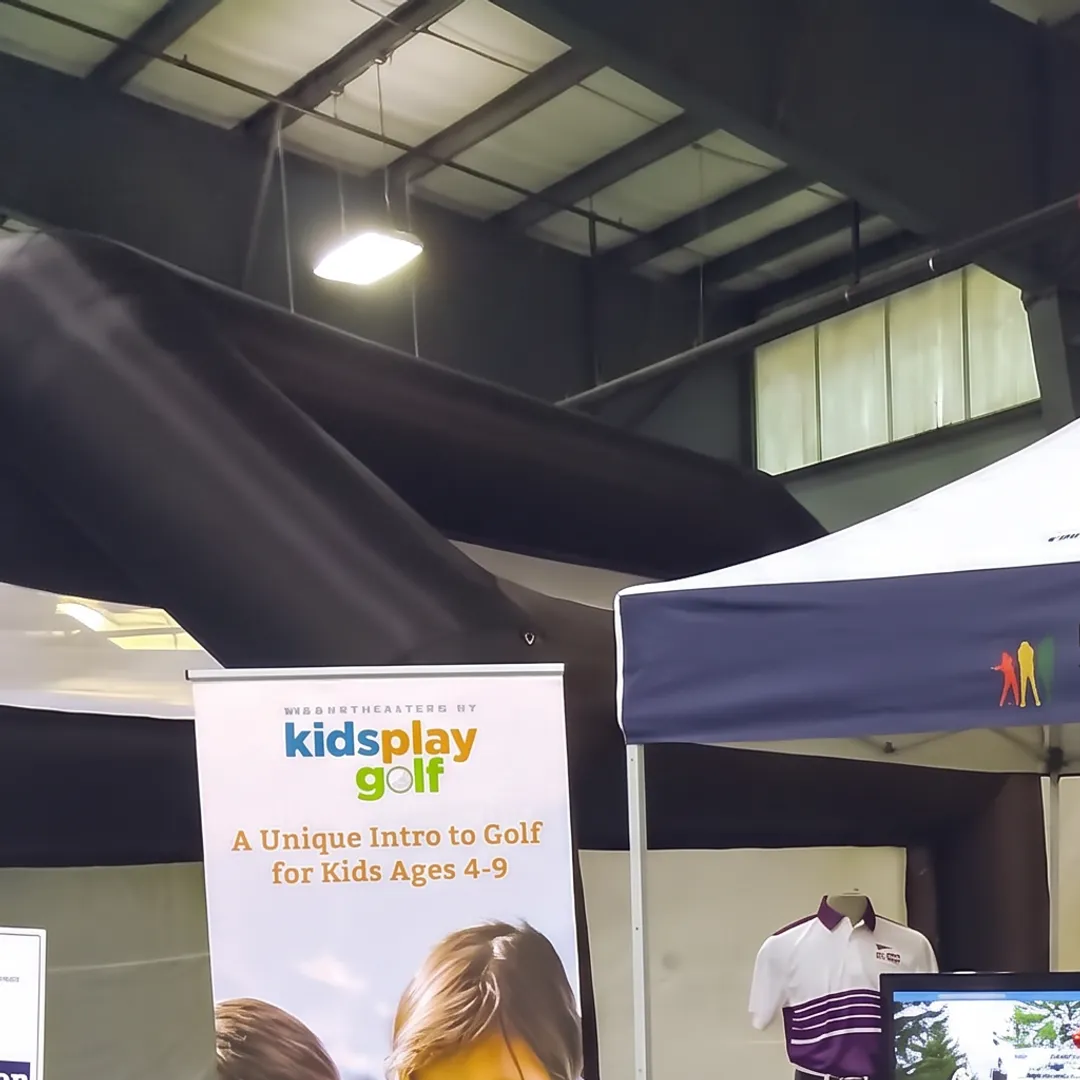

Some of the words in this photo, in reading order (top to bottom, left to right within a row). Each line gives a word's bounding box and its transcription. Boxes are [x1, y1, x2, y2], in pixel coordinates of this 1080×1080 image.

[285, 720, 478, 764] kidsplay
[356, 757, 445, 801] golf
[231, 830, 252, 852] A
[260, 827, 362, 856] Unique
[370, 826, 442, 849] Intro
[449, 824, 476, 845] to
[484, 821, 543, 845] Golf
[272, 862, 314, 885] for
[322, 859, 382, 882] Kids
[390, 859, 456, 888] Ages
[464, 857, 508, 879] 4-9
